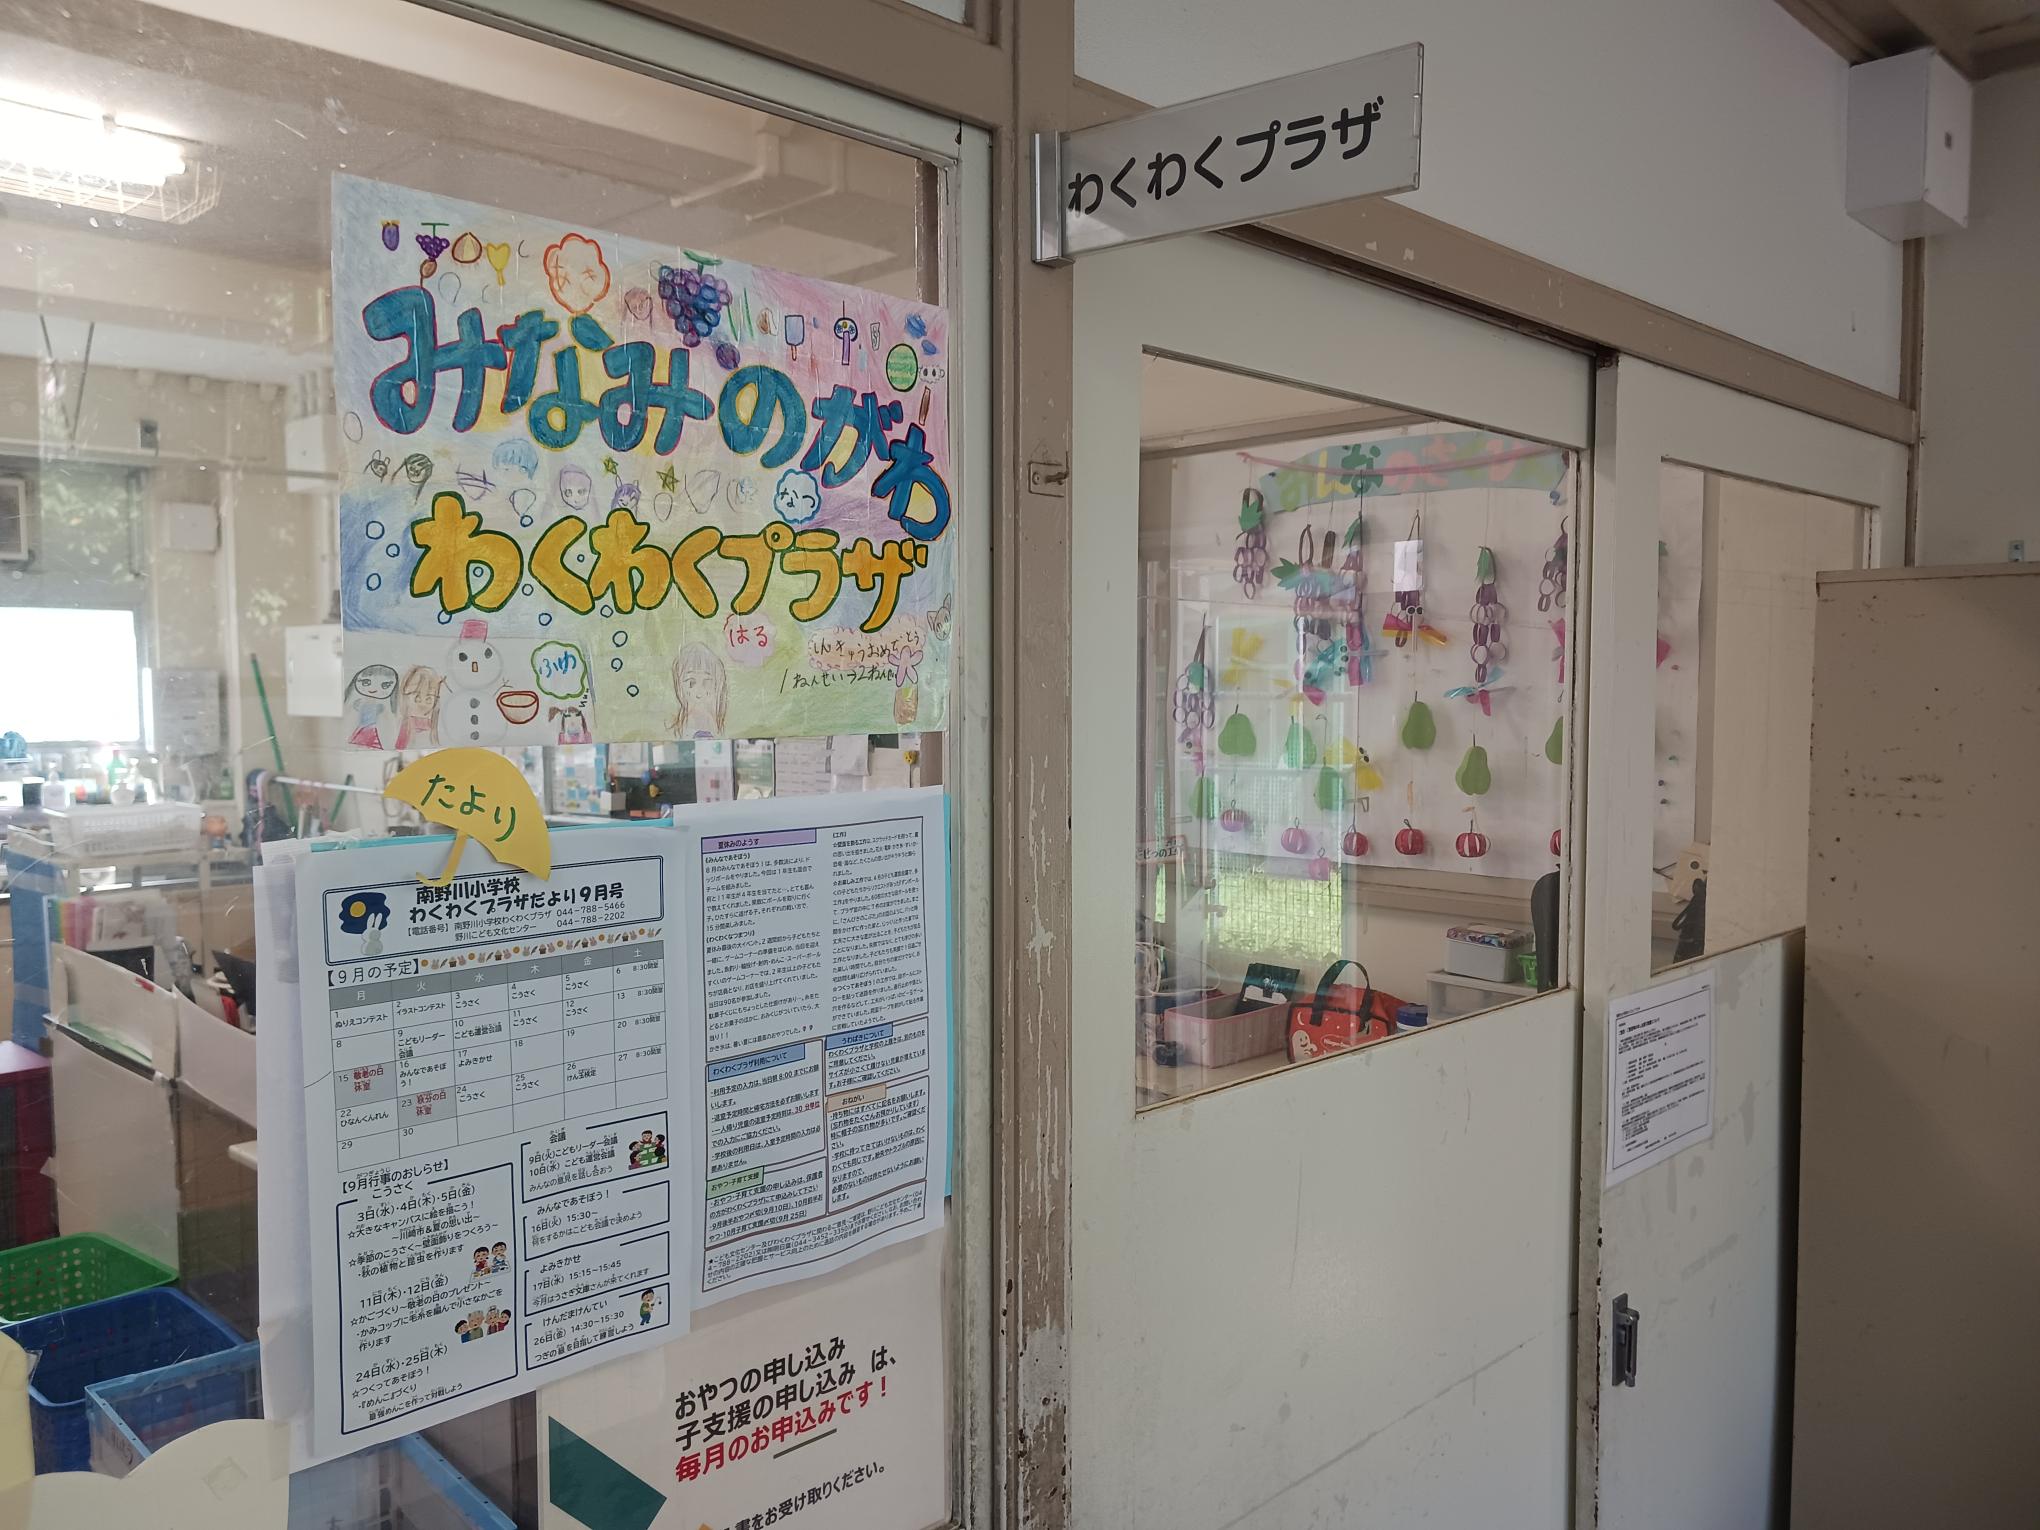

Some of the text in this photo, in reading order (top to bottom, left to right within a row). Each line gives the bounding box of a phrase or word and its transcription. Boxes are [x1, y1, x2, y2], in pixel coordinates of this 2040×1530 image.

[1067, 95, 1384, 217] わくわくプラザ
[363, 285, 951, 541] みなみのがわ
[780, 487, 816, 509] なつ
[410, 492, 928, 633] わくわくプラザ
[729, 625, 769, 648] はる
[539, 650, 577, 678] ふゆ
[420, 774, 518, 842] たより
[416, 876, 520, 904] 南野川小学校
[409, 882, 624, 923] わくわくプラザだより9月号
[454, 910, 552, 931] 南野川小学校わくわくプラザ
[556, 901, 625, 917] 044-788-5466
[455, 911, 625, 942] 野川こども文化センター 044-788-2202
[357, 949, 642, 1001] 月 火 水 木 金 土
[565, 980, 589, 991] こうさく
[511, 989, 536, 999] こうさく
[396, 1002, 446, 1015] イラストコンテスト
[455, 998, 480, 1009] こうさく
[565, 1006, 588, 1017] こうさく
[335, 1014, 388, 1029] ぬりえコンテスト
[513, 1016, 538, 1027] こうさく
[398, 1034, 445, 1046] こどもリーダー
[567, 1029, 575, 1037] 19
[842, 1030, 885, 1044] うわばきについて
[458, 1055, 493, 1067] よみきかせ
[399, 1063, 447, 1078] みんなであそぼ
[515, 1074, 525, 1082] 25
[515, 1080, 540, 1091] こうさく
[459, 1091, 486, 1103] こうさく
[842, 1094, 865, 1105] おねがい
[340, 1109, 352, 1117] 22
[340, 1111, 389, 1127] ひなんくんれん
[403, 1128, 414, 1136] 30
[549, 1132, 566, 1143] 会議
[341, 1141, 353, 1150] 29
[372, 1180, 413, 1199] こうさく
[540, 1254, 581, 1274] よみきかせ
[542, 1300, 608, 1327] けんだまけんてい
[359, 1335, 392, 1352] 作ります
[871, 1346, 897, 1373] は、
[674, 1336, 846, 1422] おやつの申し込み
[675, 1361, 856, 1452] 子支援の申し込み
[674, 1376, 887, 1484] 毎月のお申込みです!
[719, 1461, 885, 1530] 書をお受け取りください。
